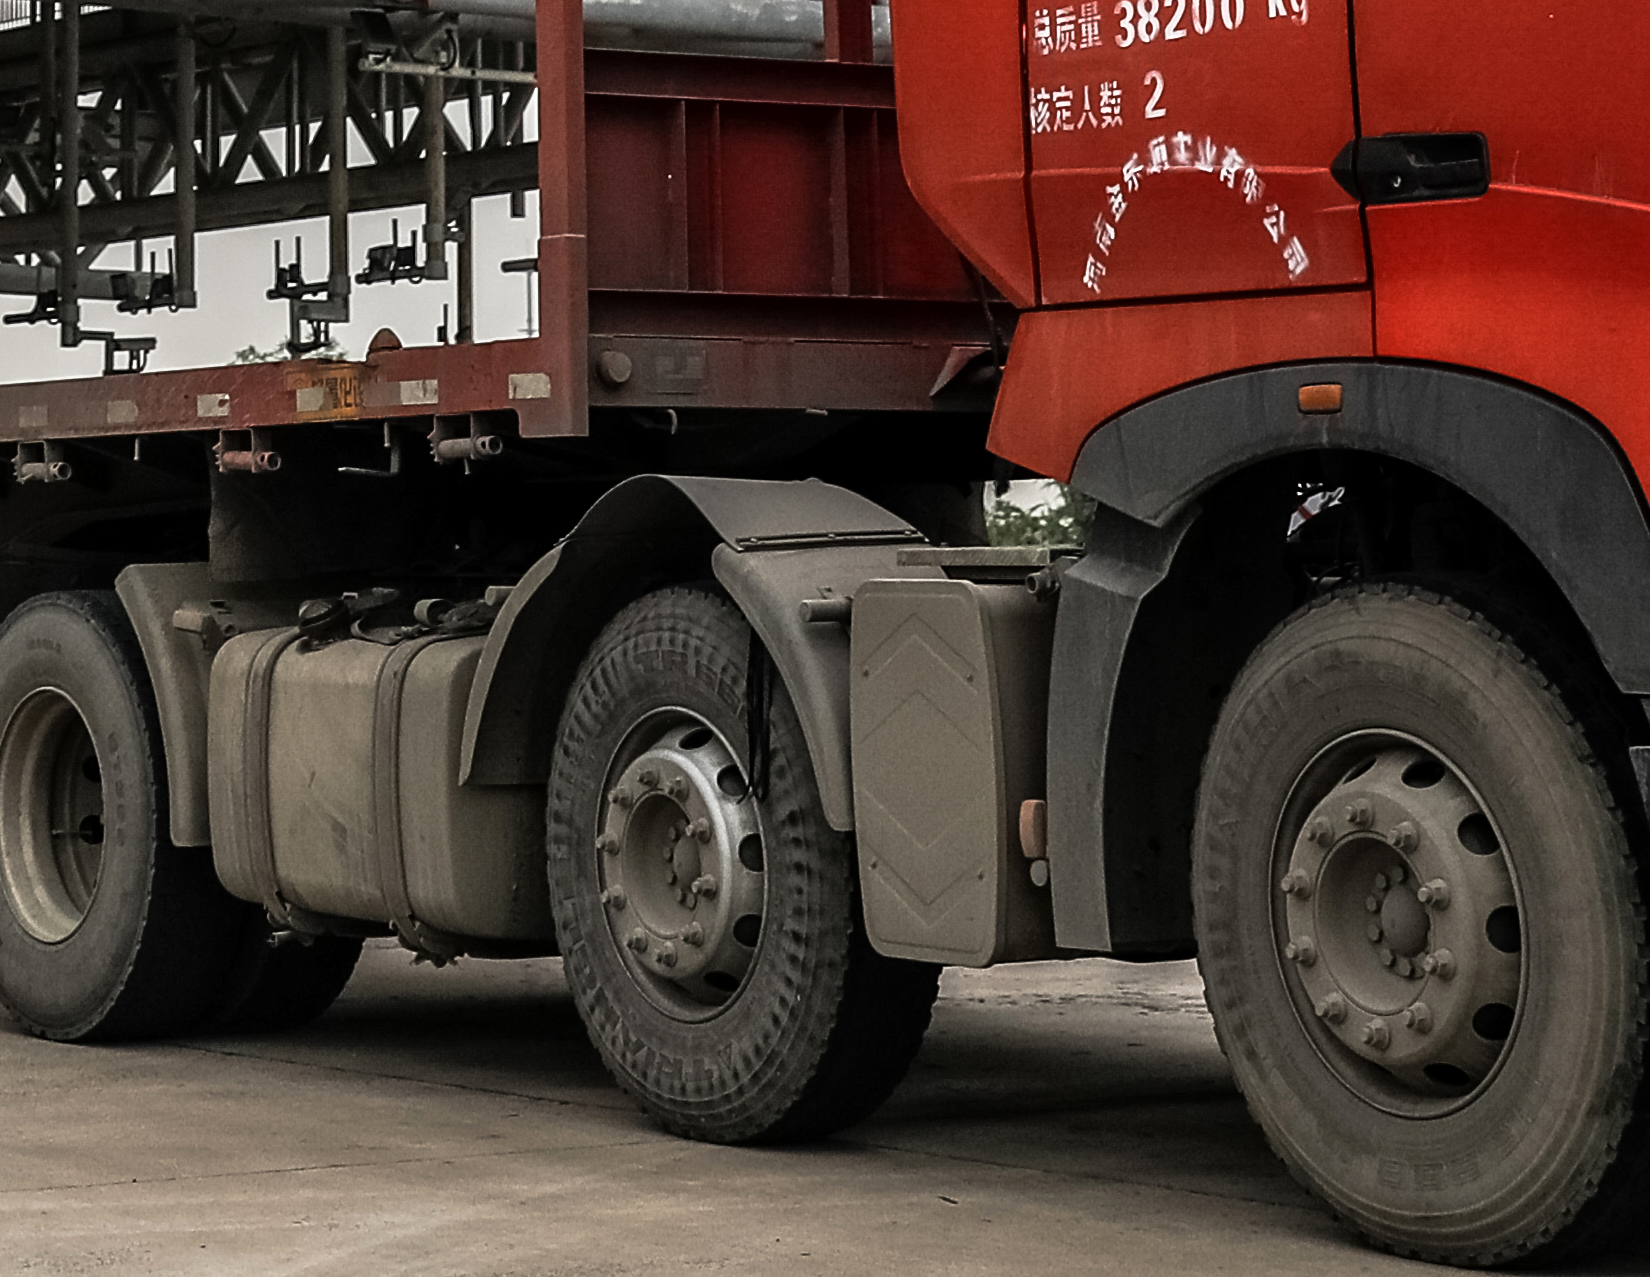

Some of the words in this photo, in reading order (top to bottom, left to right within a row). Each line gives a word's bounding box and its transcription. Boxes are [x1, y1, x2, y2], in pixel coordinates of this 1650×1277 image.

[1032, 0, 1103, 56] 总质量
[1029, 79, 1124, 135] 核定人数
[1143, 69, 1168, 120] 2
